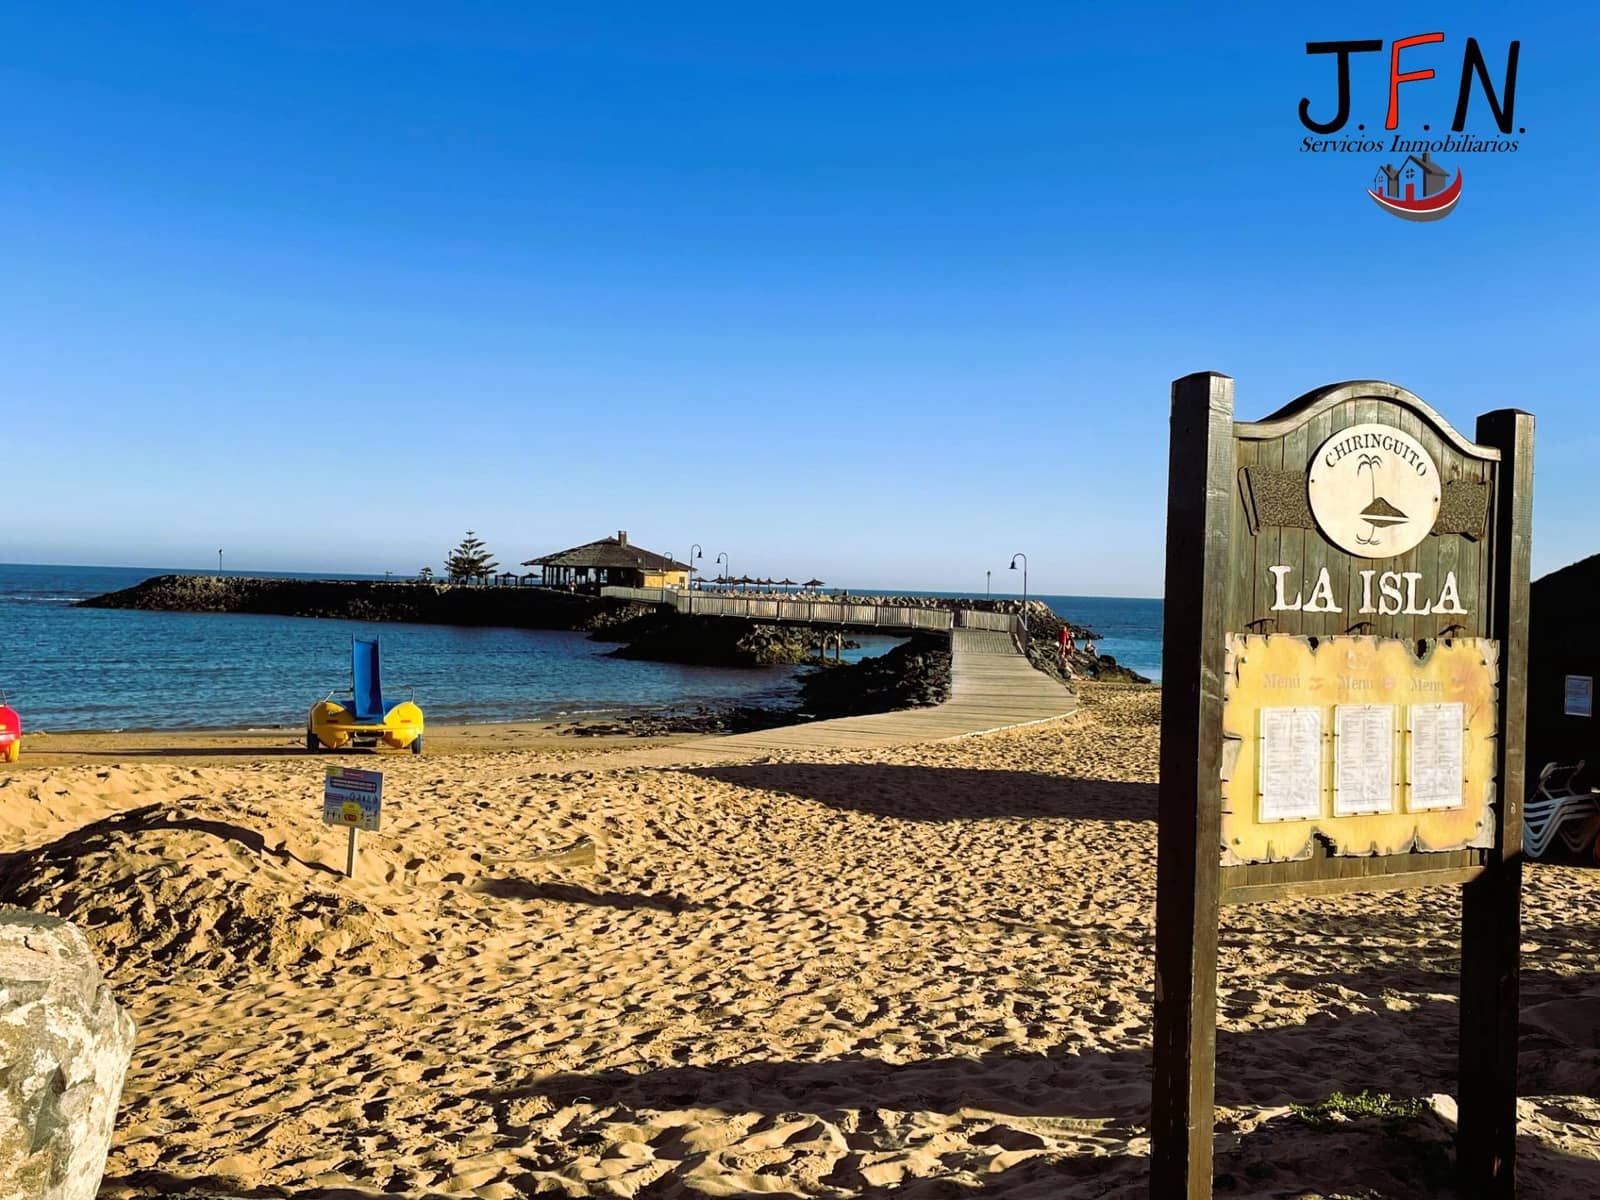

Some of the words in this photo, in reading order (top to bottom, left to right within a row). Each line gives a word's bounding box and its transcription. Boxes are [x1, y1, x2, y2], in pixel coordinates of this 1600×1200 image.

[1325, 433, 1427, 477] CHIRINGUITO
[1269, 565, 1343, 613] LA
[1358, 570, 1468, 616] ISLA
